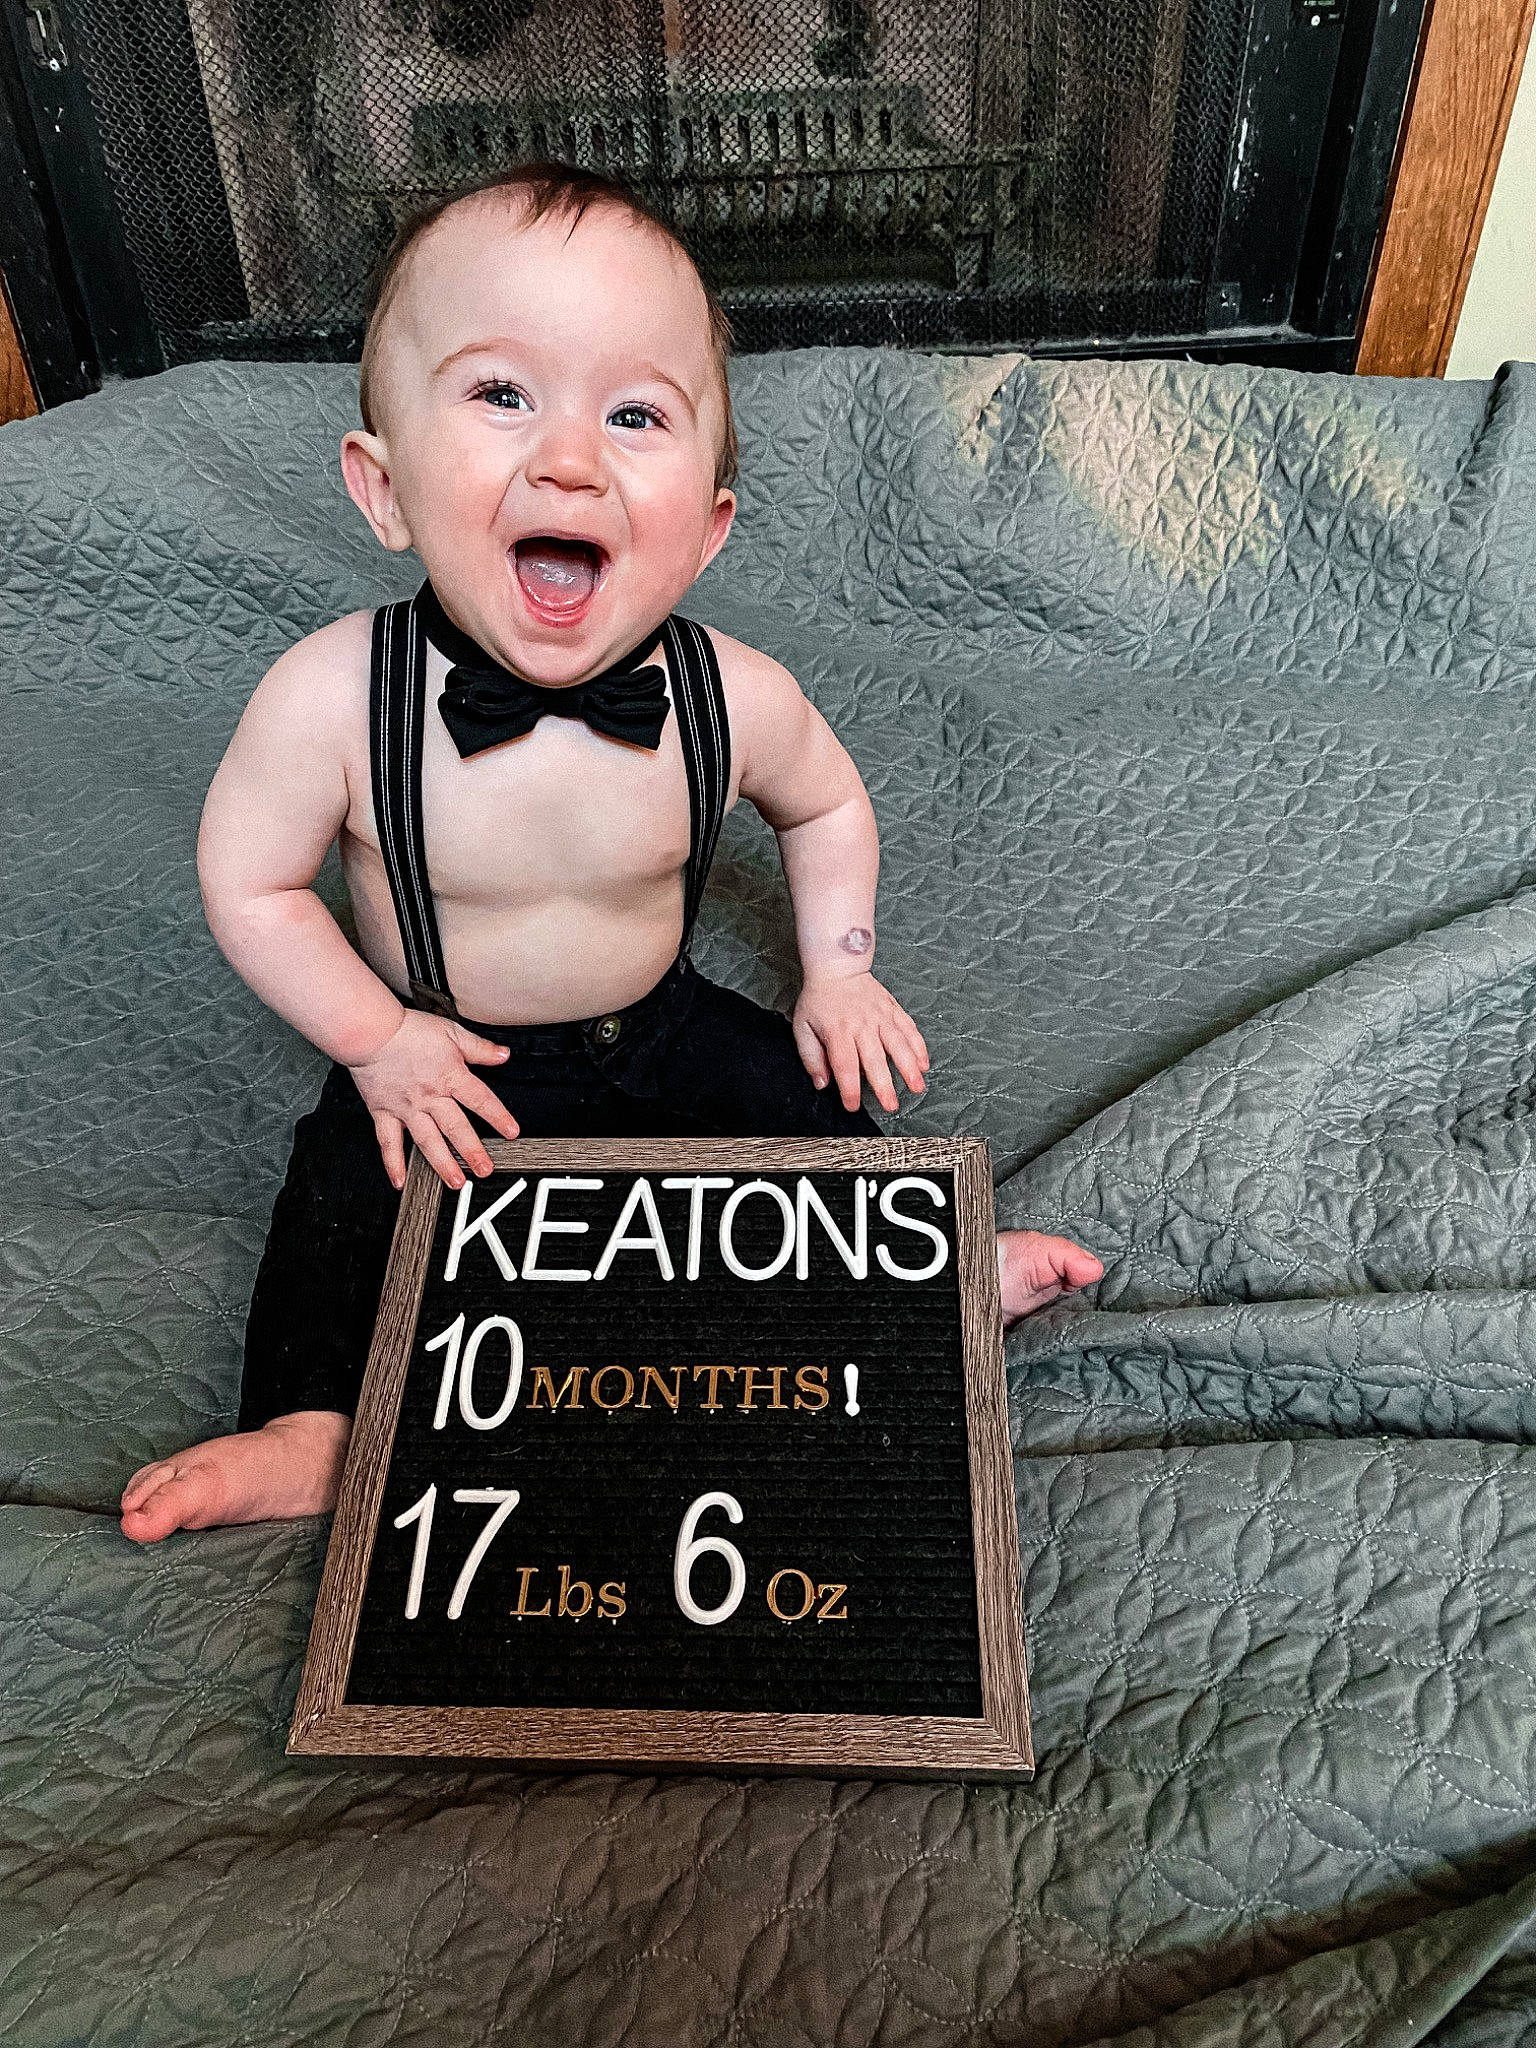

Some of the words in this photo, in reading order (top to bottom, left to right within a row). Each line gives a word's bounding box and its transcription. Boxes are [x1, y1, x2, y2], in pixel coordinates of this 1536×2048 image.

[444, 1177, 949, 1281] KEATON'S
[425, 1313, 524, 1430] 10
[394, 1484, 520, 1620] 17
[510, 1566, 627, 1619] Lbs
[674, 1491, 746, 1626] 6
[766, 1568, 848, 1620] Oz
